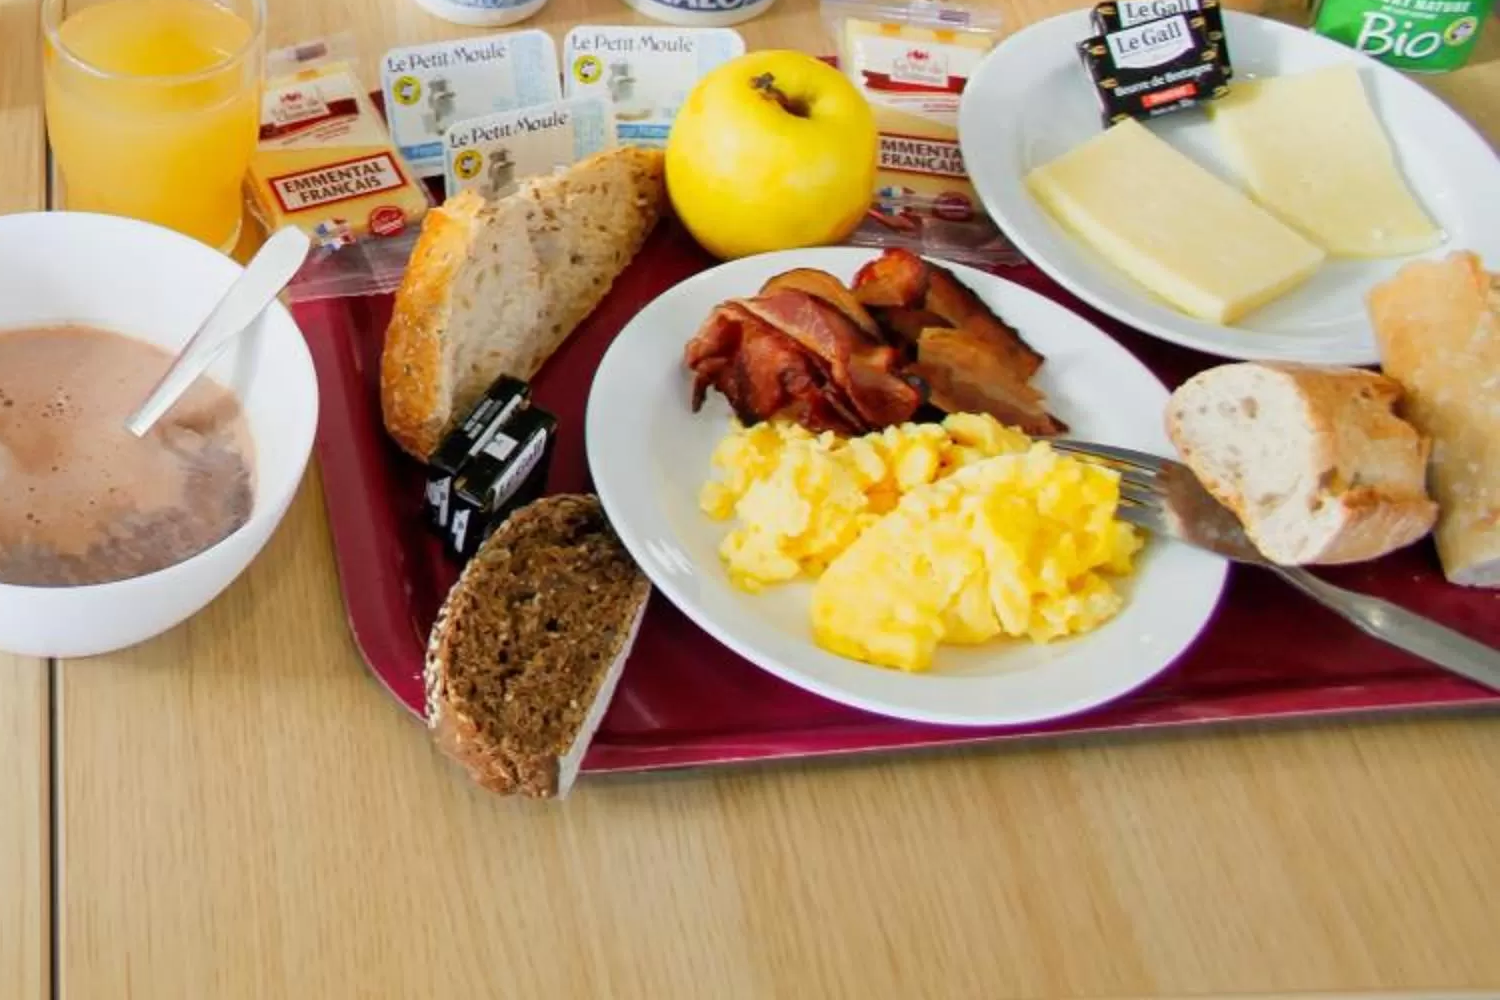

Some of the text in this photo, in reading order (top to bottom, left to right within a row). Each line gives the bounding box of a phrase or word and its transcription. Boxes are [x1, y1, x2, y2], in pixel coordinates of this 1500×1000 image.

[1126, 2, 1149, 19] Le
[571, 34, 592, 50] Le
[1115, 21, 1183, 53] Le Gall
[1356, 10, 1441, 58] Bio
[387, 56, 406, 73] Le
[408, 49, 449, 70] Petit
[450, 132, 470, 149] Le
[471, 124, 511, 144] Petit
[880, 138, 963, 161] MMENTA
[283, 160, 386, 194] EMMENTAL
